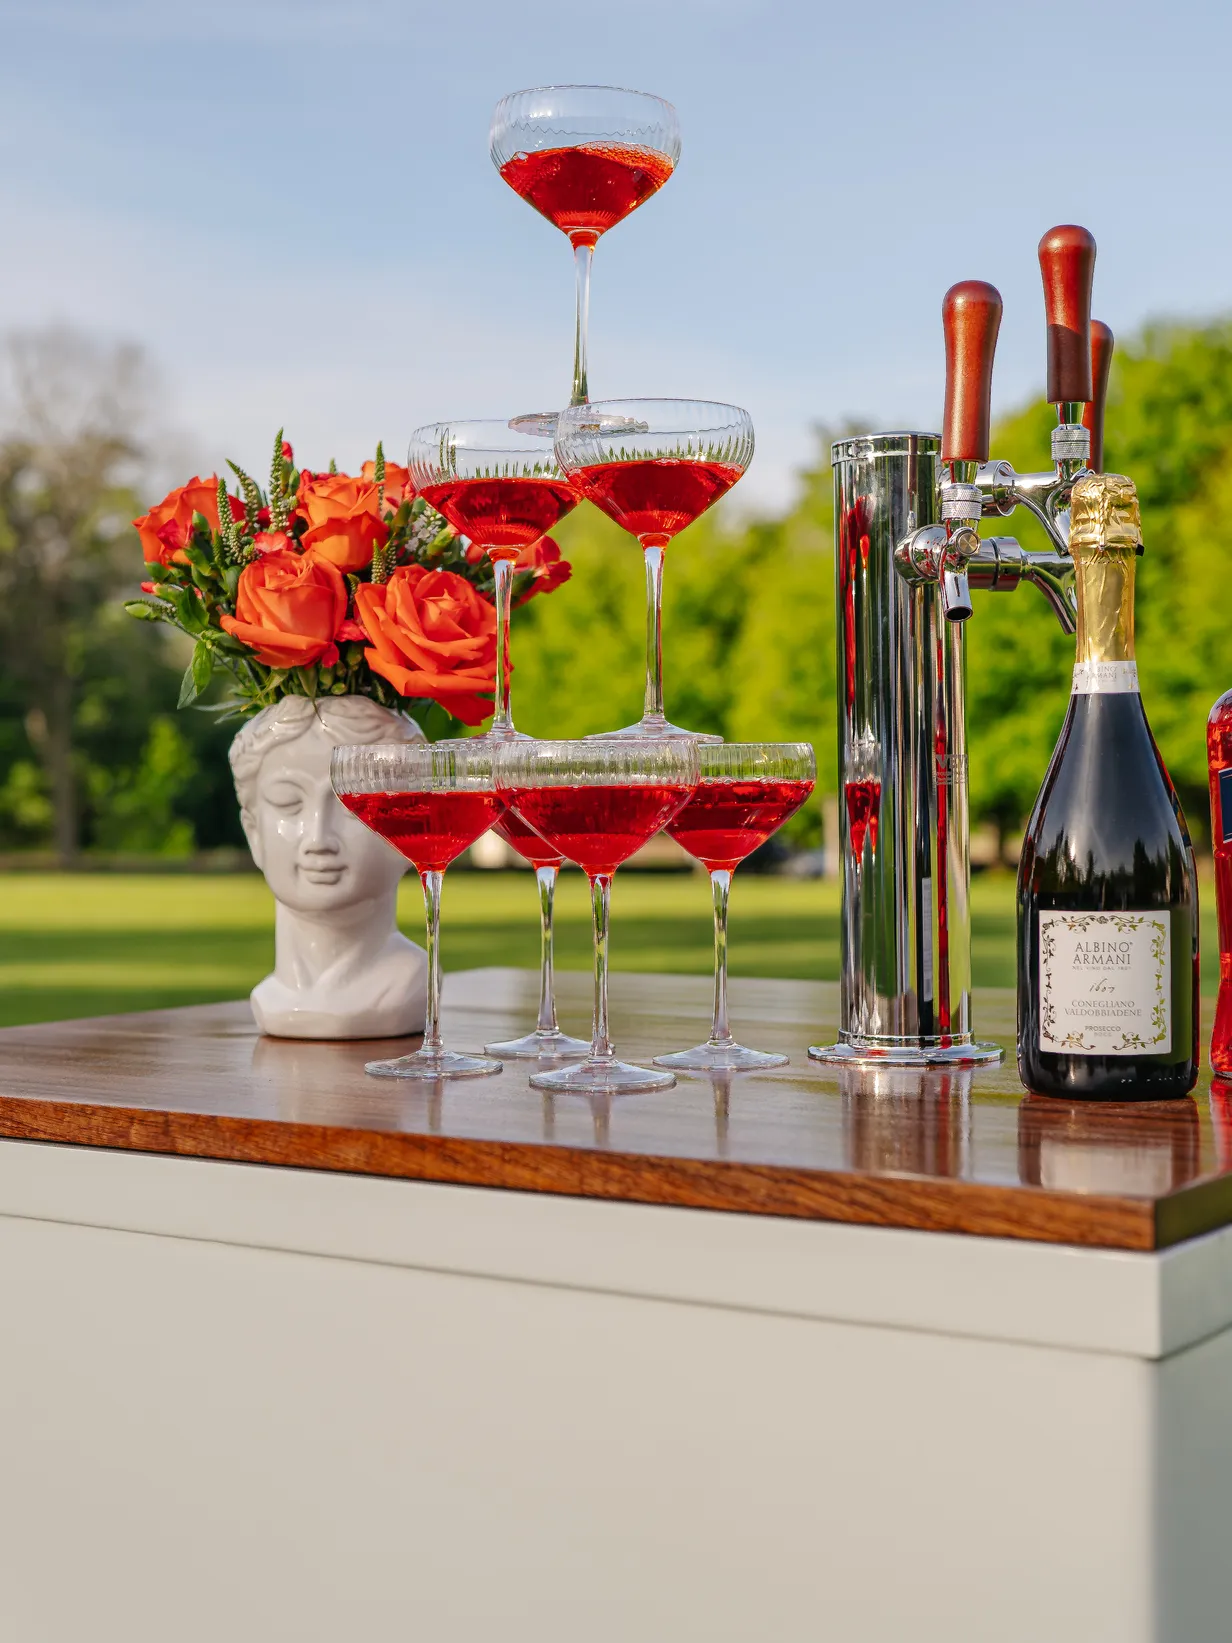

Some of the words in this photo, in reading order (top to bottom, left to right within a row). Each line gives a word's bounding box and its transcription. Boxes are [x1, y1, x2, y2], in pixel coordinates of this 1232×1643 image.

[1075, 941, 1130, 953] ALBINO
[1073, 953, 1131, 965] ARMANI
[1071, 1000, 1135, 1008] CONEGLIANO
[1064, 1008, 1142, 1017] VALDOBBIADENE
